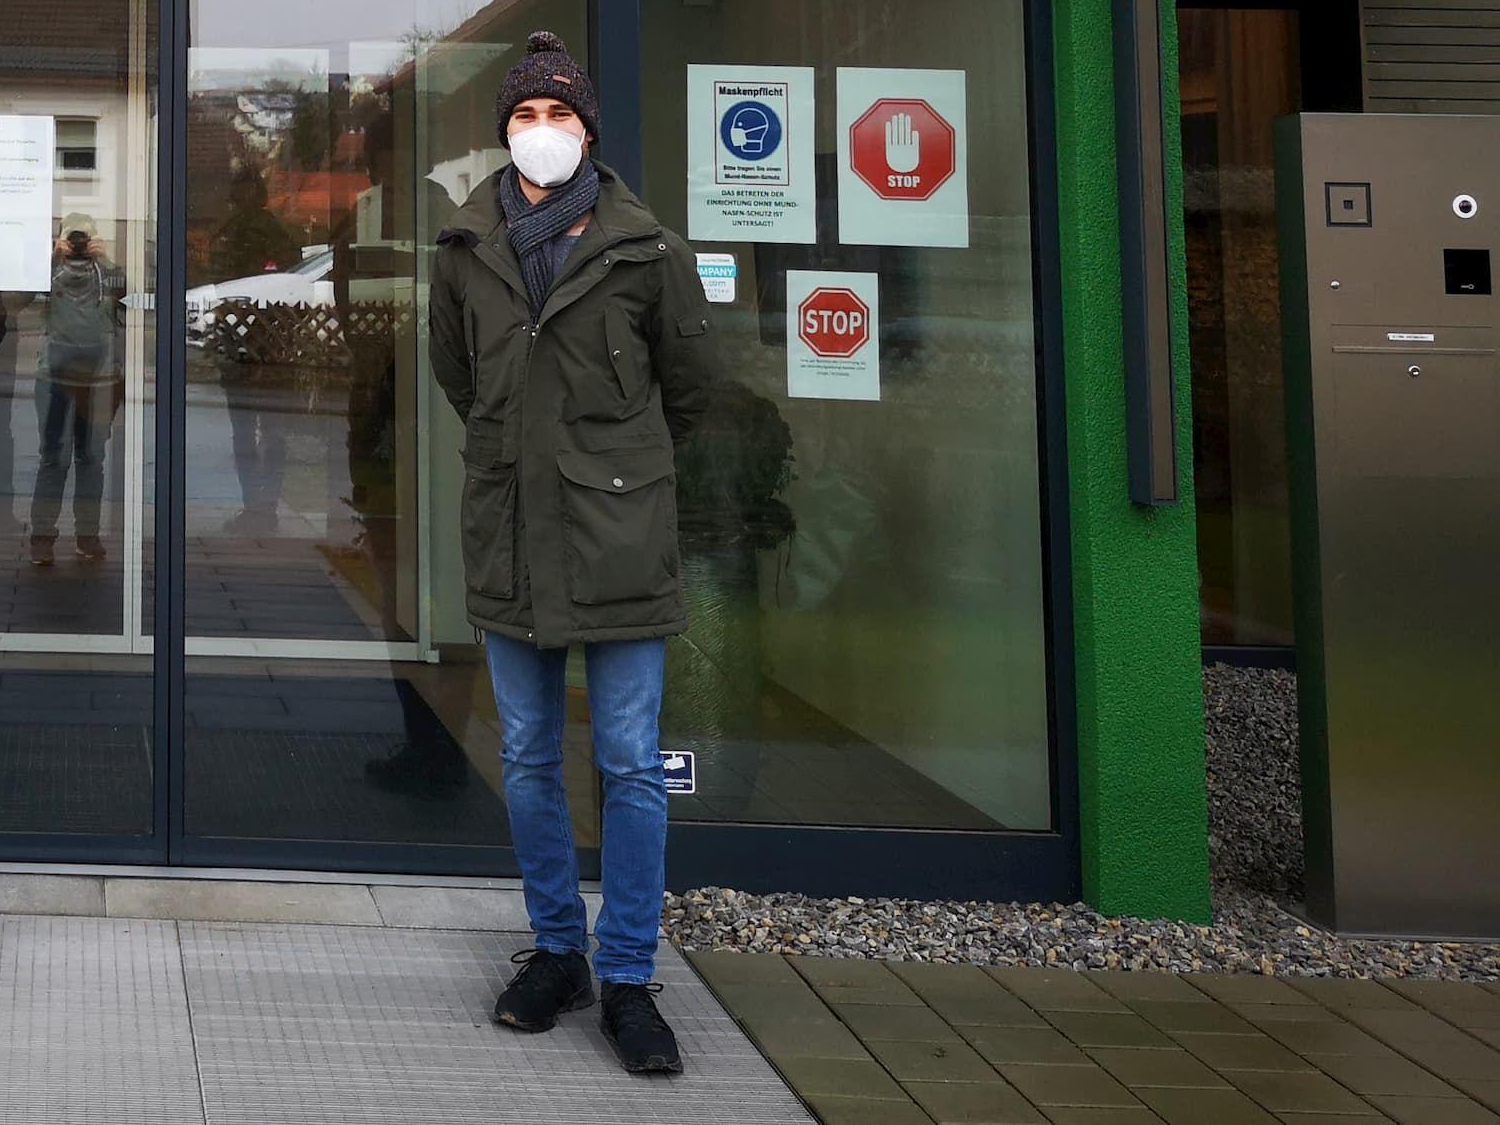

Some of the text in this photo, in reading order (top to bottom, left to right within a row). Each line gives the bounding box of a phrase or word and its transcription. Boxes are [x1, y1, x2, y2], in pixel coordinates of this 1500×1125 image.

[718, 86, 784, 98] Maskenpflicht
[887, 175, 921, 188] STOP
[736, 190, 769, 198] BETRETEN
[706, 199, 752, 207] EINRICHTUNG
[722, 210, 772, 218] NASEN-SCHUTZ
[732, 220, 774, 228] UNTERSAGT!
[699, 267, 733, 276] MPANY
[805, 309, 863, 336] STOP
